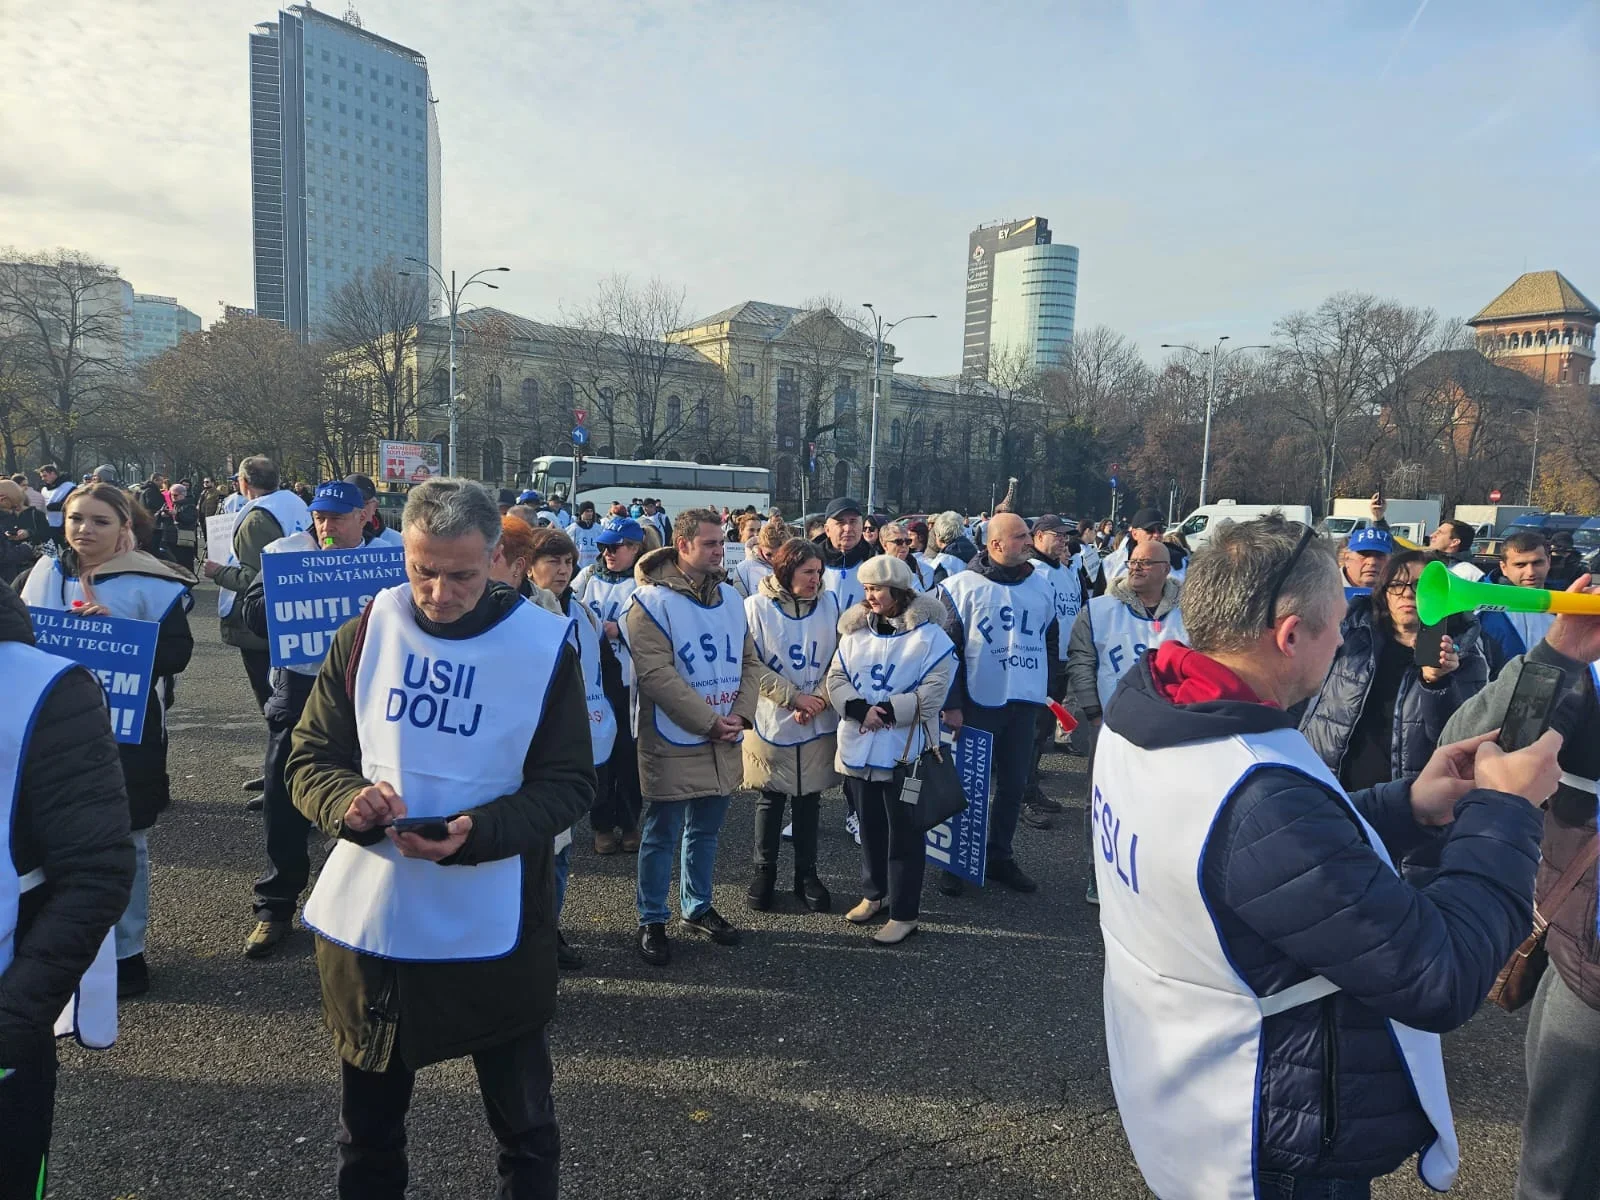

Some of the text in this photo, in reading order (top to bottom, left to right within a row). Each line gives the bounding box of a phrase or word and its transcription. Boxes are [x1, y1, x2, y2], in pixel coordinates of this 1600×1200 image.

[998, 228, 1010, 239] EY
[319, 489, 344, 499] FSLI
[1358, 529, 1388, 542] FSLI
[302, 552, 405, 567] SINDICATUL LI
[278, 576, 304, 586] DIN
[274, 594, 374, 624] UNIȚI S
[62, 617, 113, 634] LIBER
[33, 630, 140, 656] ÂNT TECUCI
[403, 653, 476, 699] USII
[999, 655, 1038, 671] TCUCI
[91, 668, 141, 696] EM
[385, 687, 483, 737] DOLJ
[963, 738, 973, 766] DIN
[969, 736, 987, 876] SINDICATUL LIBER
[1093, 784, 1139, 895] FSLI
